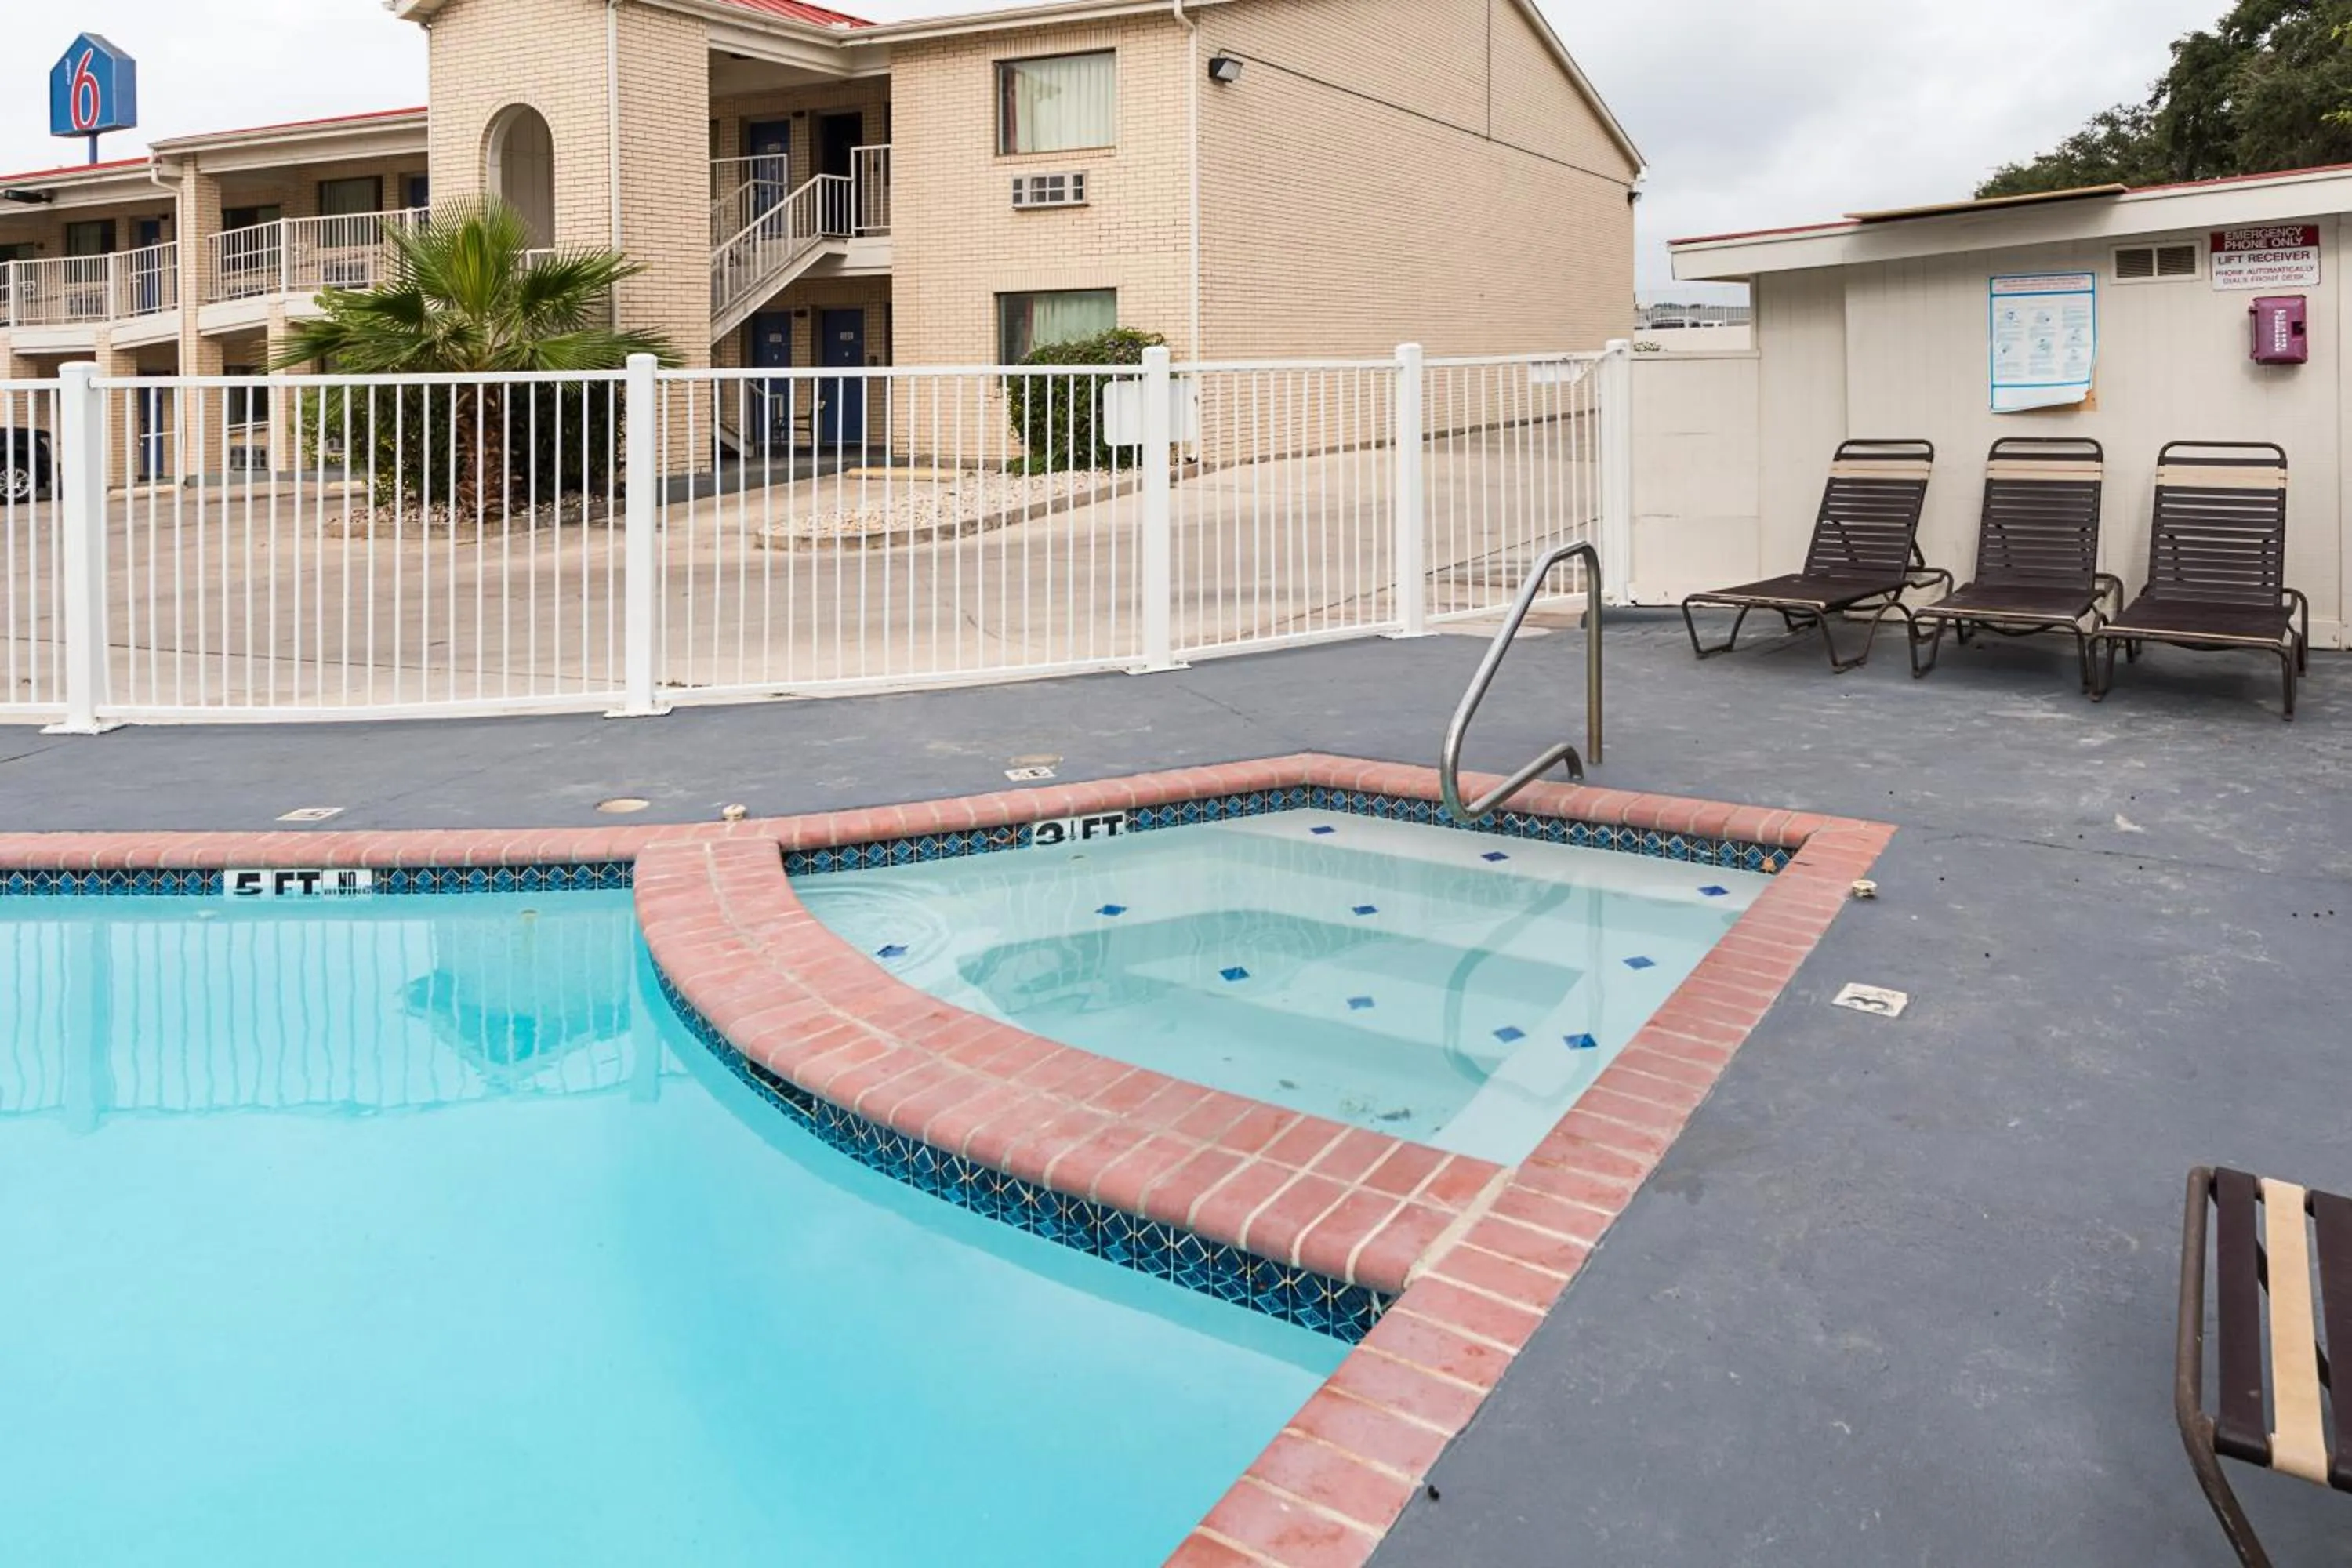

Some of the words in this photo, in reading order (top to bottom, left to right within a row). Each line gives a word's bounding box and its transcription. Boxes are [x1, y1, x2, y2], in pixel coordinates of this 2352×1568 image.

[70, 48, 101, 131] 6
[2224, 226, 2303, 241] EMERGENCY
[2224, 238, 2268, 251] PHONE
[2271, 236, 2303, 247] ONLY
[2217, 254, 2244, 265] LIFT
[2248, 250, 2311, 263] RECEIVER
[1036, 822, 1065, 845] 3
[234, 873, 263, 895] 5
[338, 871, 356, 887] NO
